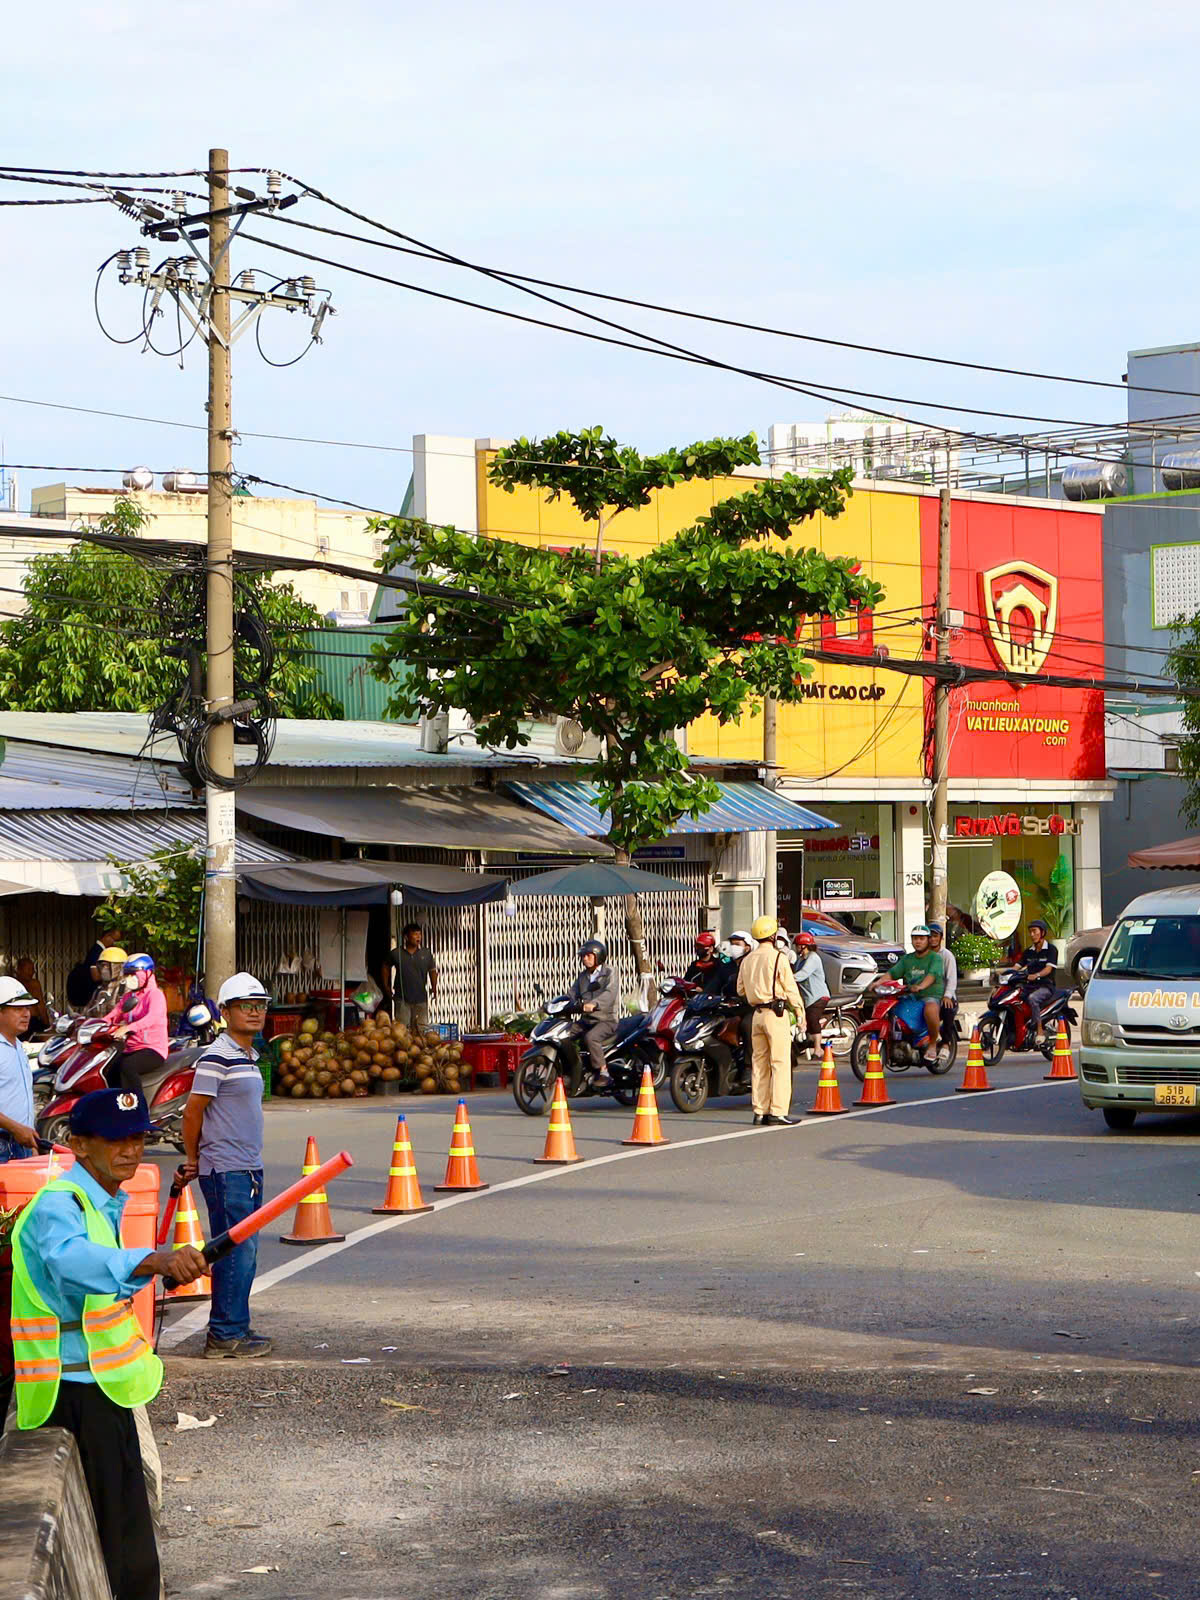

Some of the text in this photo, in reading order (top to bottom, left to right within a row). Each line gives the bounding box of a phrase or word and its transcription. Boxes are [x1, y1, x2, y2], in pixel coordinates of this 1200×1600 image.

[801, 681, 886, 700] HẤT CAO CẤP
[967, 699, 1020, 712] muanhanh
[967, 716, 1070, 733] VATLIEUXAYDUNG
[1043, 736, 1067, 746] .com
[1023, 814, 1083, 836] SPORT
[905, 873, 923, 886] 258
[1128, 988, 1187, 1009] HOÀNG
[1166, 1085, 1184, 1095] 51B
[1159, 1095, 1191, 1105] 285.24
